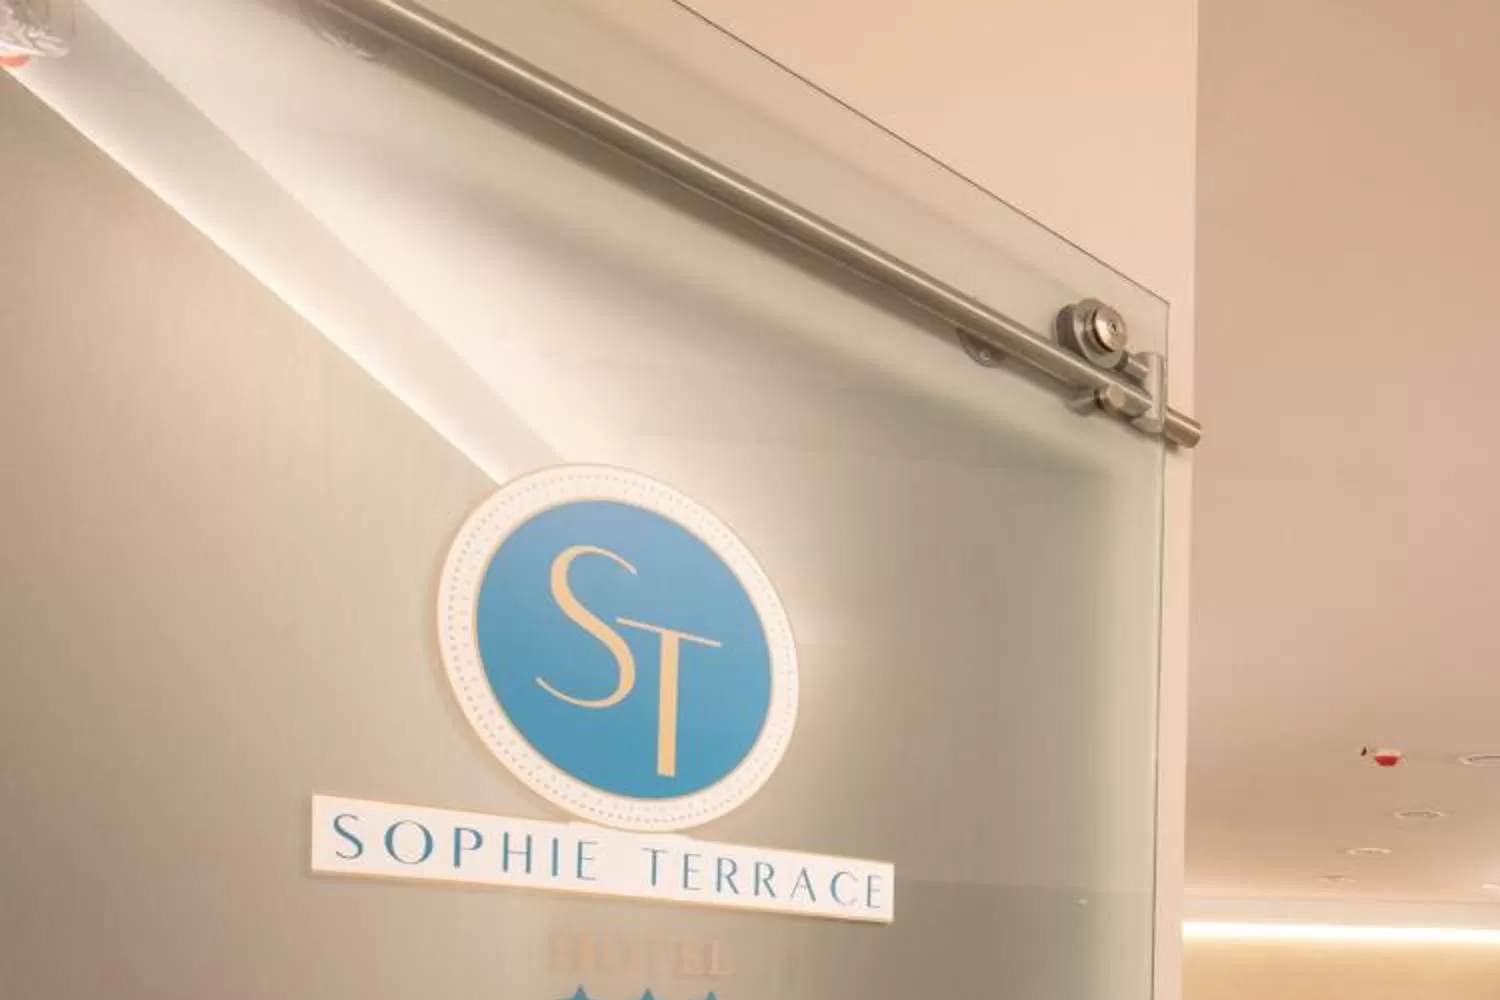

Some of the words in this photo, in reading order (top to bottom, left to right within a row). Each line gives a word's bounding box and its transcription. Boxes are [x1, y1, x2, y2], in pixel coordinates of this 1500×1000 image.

[535, 544, 722, 778] ST
[332, 812, 599, 882] SOPHIE
[641, 847, 883, 911] TERRACE
[549, 930, 734, 977] HOTEL
